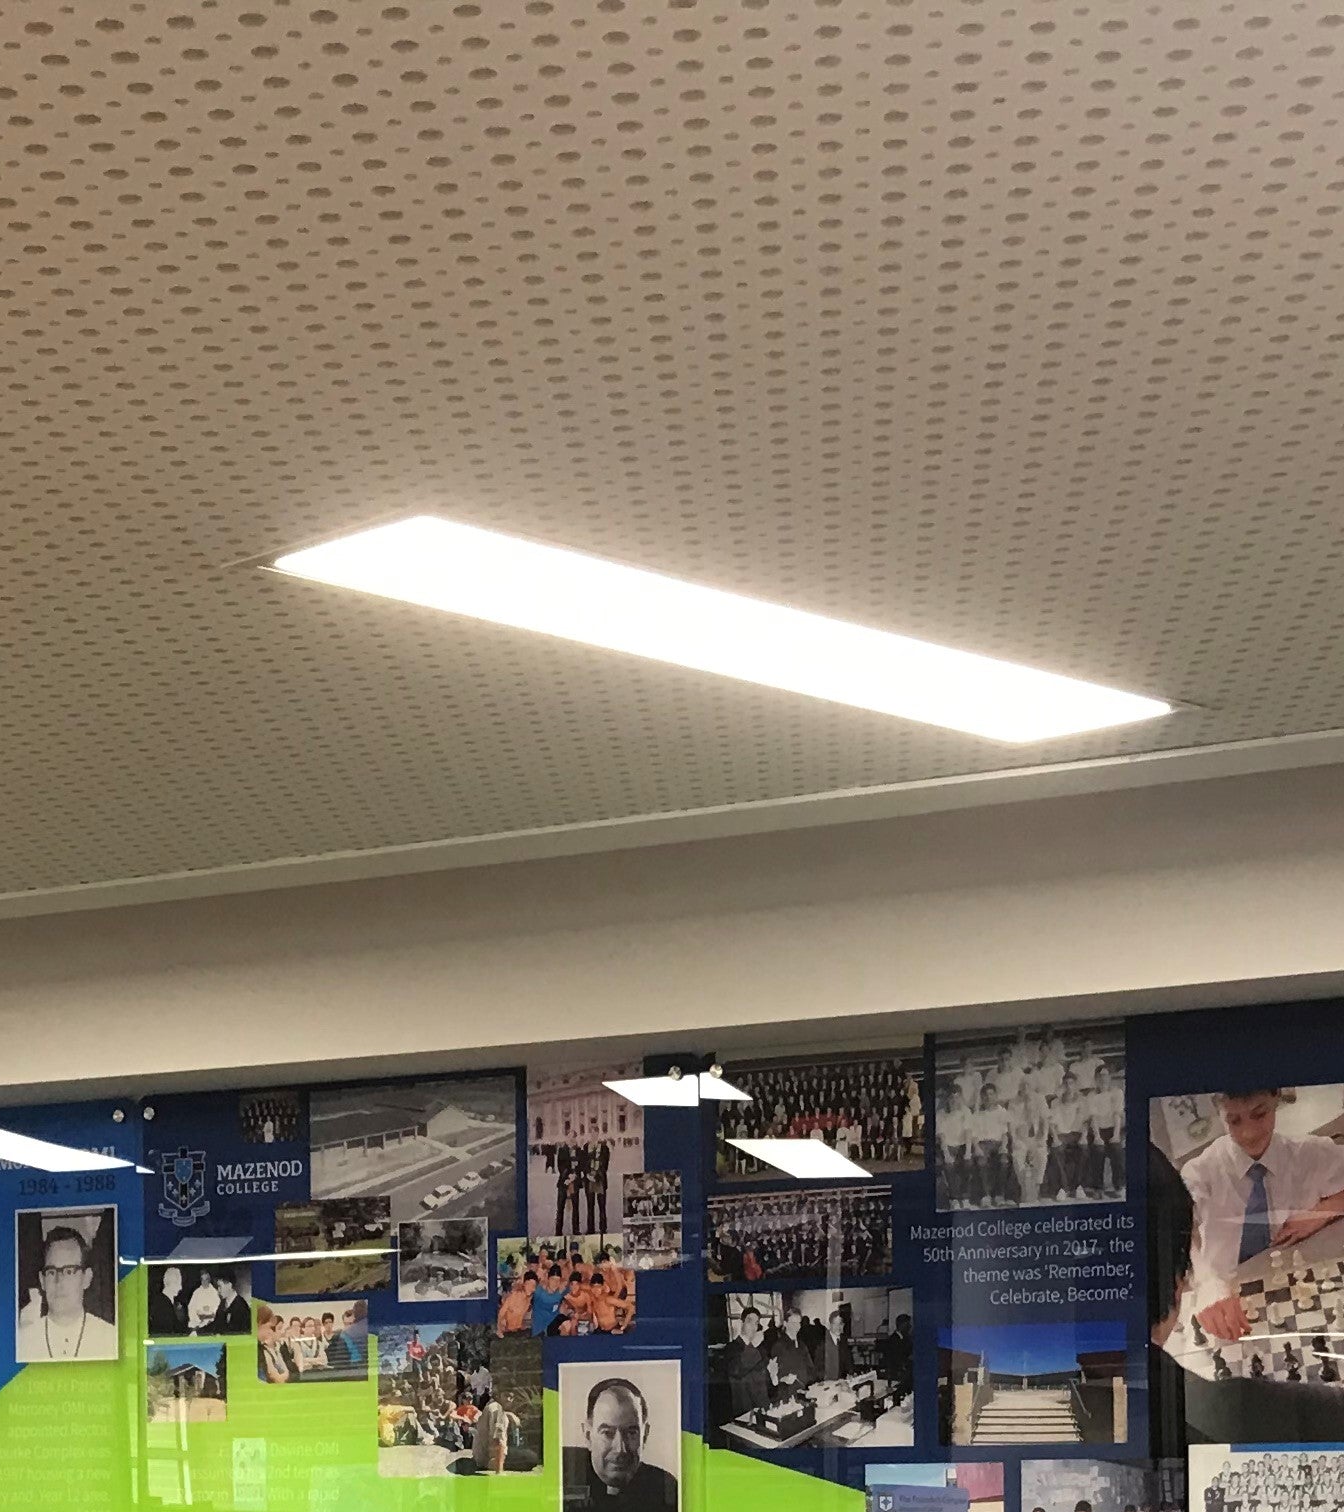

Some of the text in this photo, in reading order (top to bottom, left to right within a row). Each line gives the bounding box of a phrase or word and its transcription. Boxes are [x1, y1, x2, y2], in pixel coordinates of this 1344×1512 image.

[216, 1160, 302, 1180] MAZENOD
[216, 1180, 278, 1195] COLLEGE
[910, 1214, 1134, 1239] Mazenod College celebrated its
[923, 1237, 1134, 1262] 50th Anniversary in 2017, the
[963, 1268, 1009, 1283] theme
[1012, 1268, 1041, 1280] was
[989, 1288, 1063, 1304] Celebrate,
